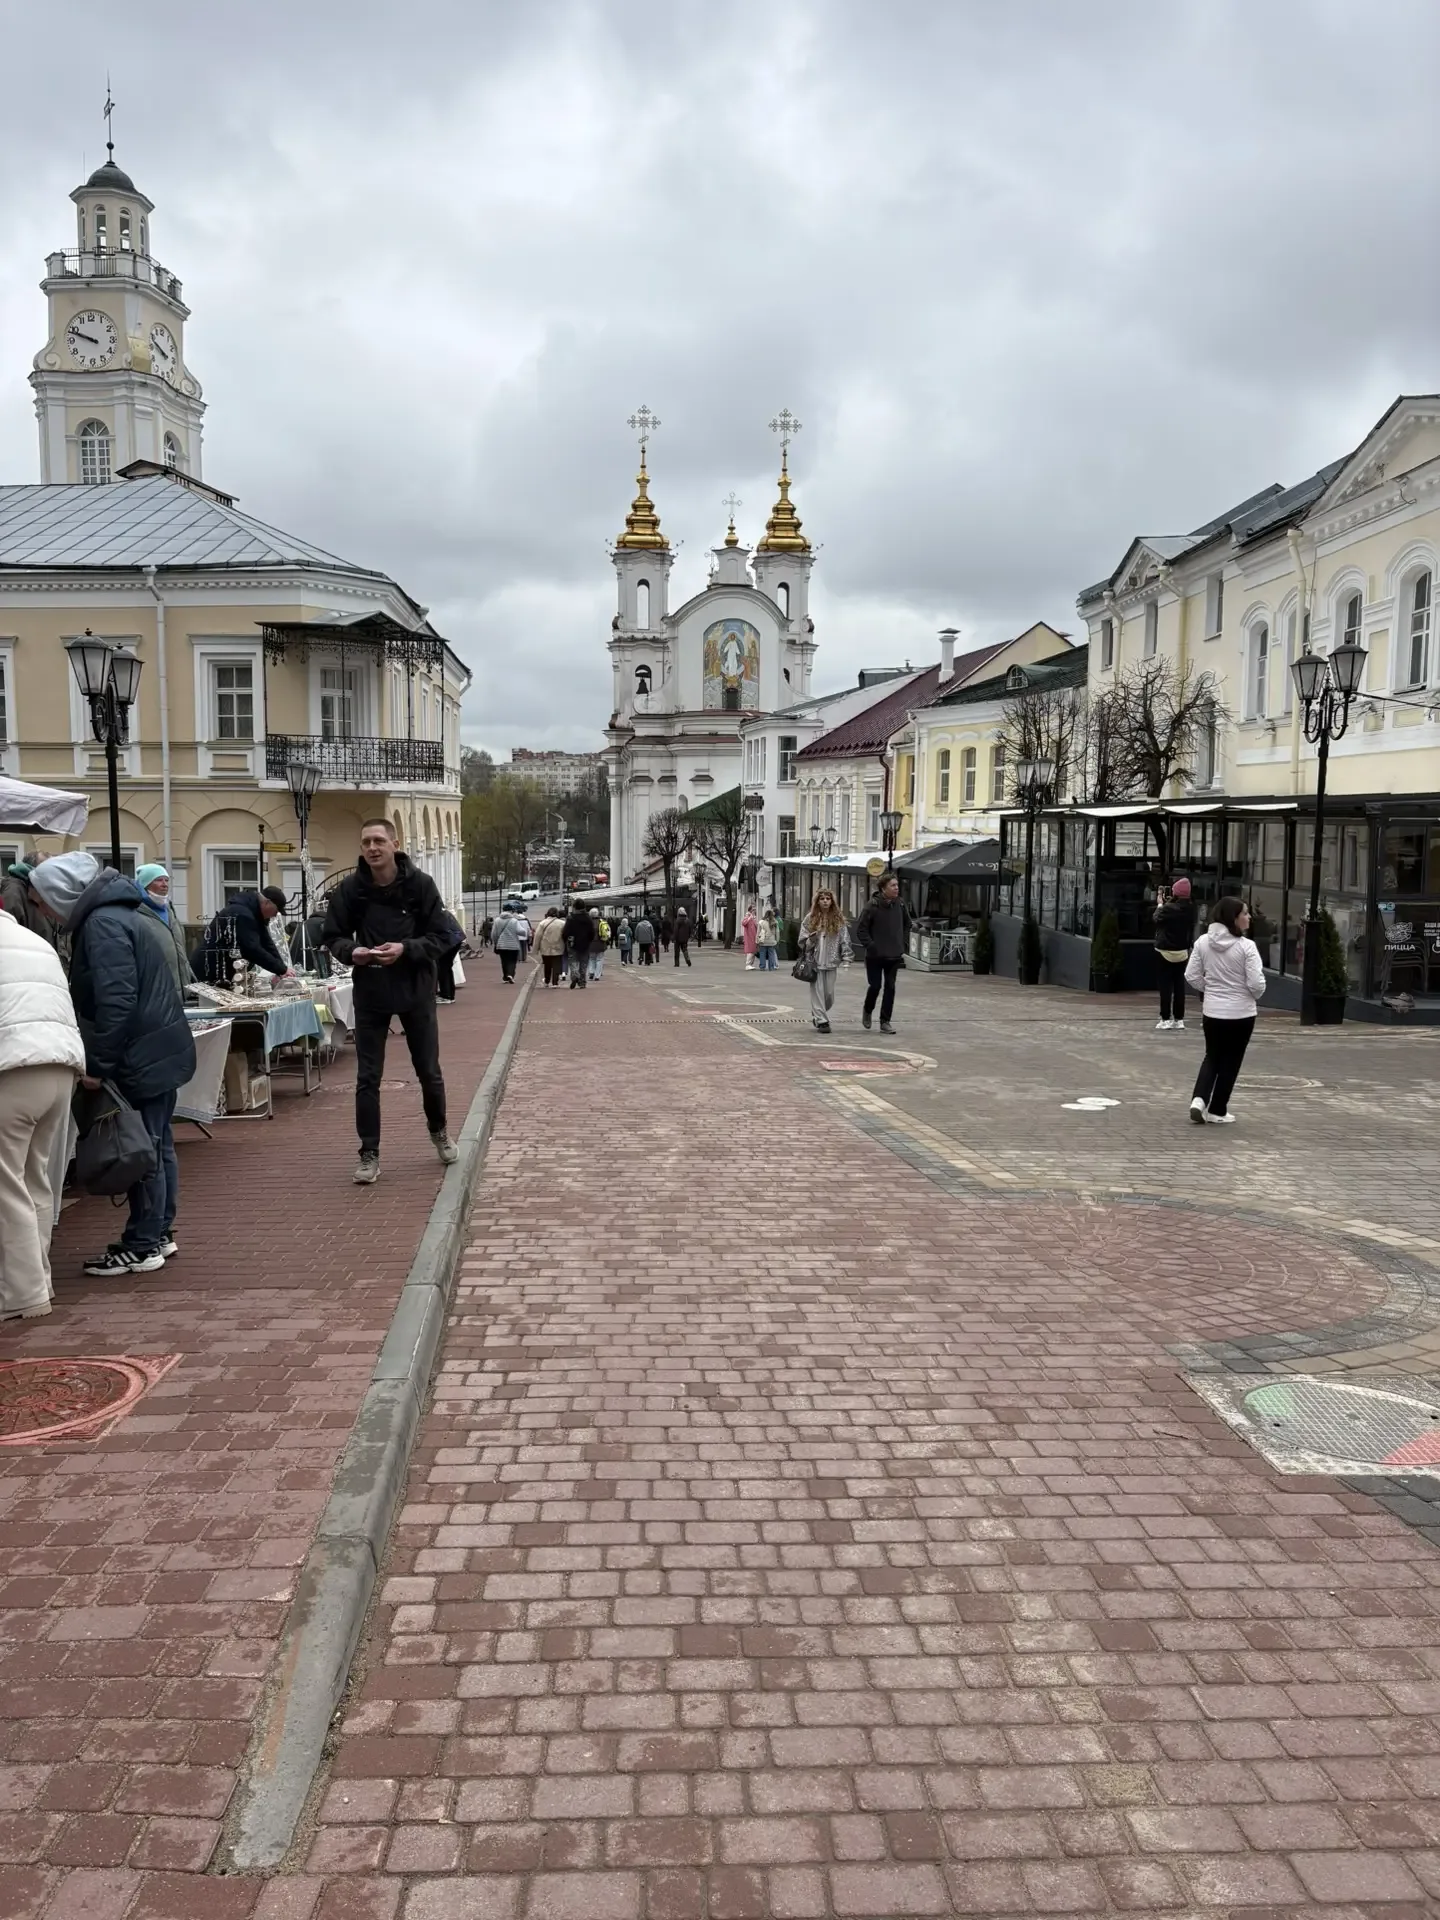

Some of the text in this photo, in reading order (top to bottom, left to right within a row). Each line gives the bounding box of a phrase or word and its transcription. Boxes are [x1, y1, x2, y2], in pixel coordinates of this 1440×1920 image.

[78, 316, 85, 324] 11
[69, 336, 76, 344] 9
[109, 335, 116, 344] 3
[72, 347, 79, 355] 8
[106, 346, 113, 354] 4
[80, 355, 86, 364] 7
[90, 358, 97, 367] 6
[100, 355, 107, 364] 5
